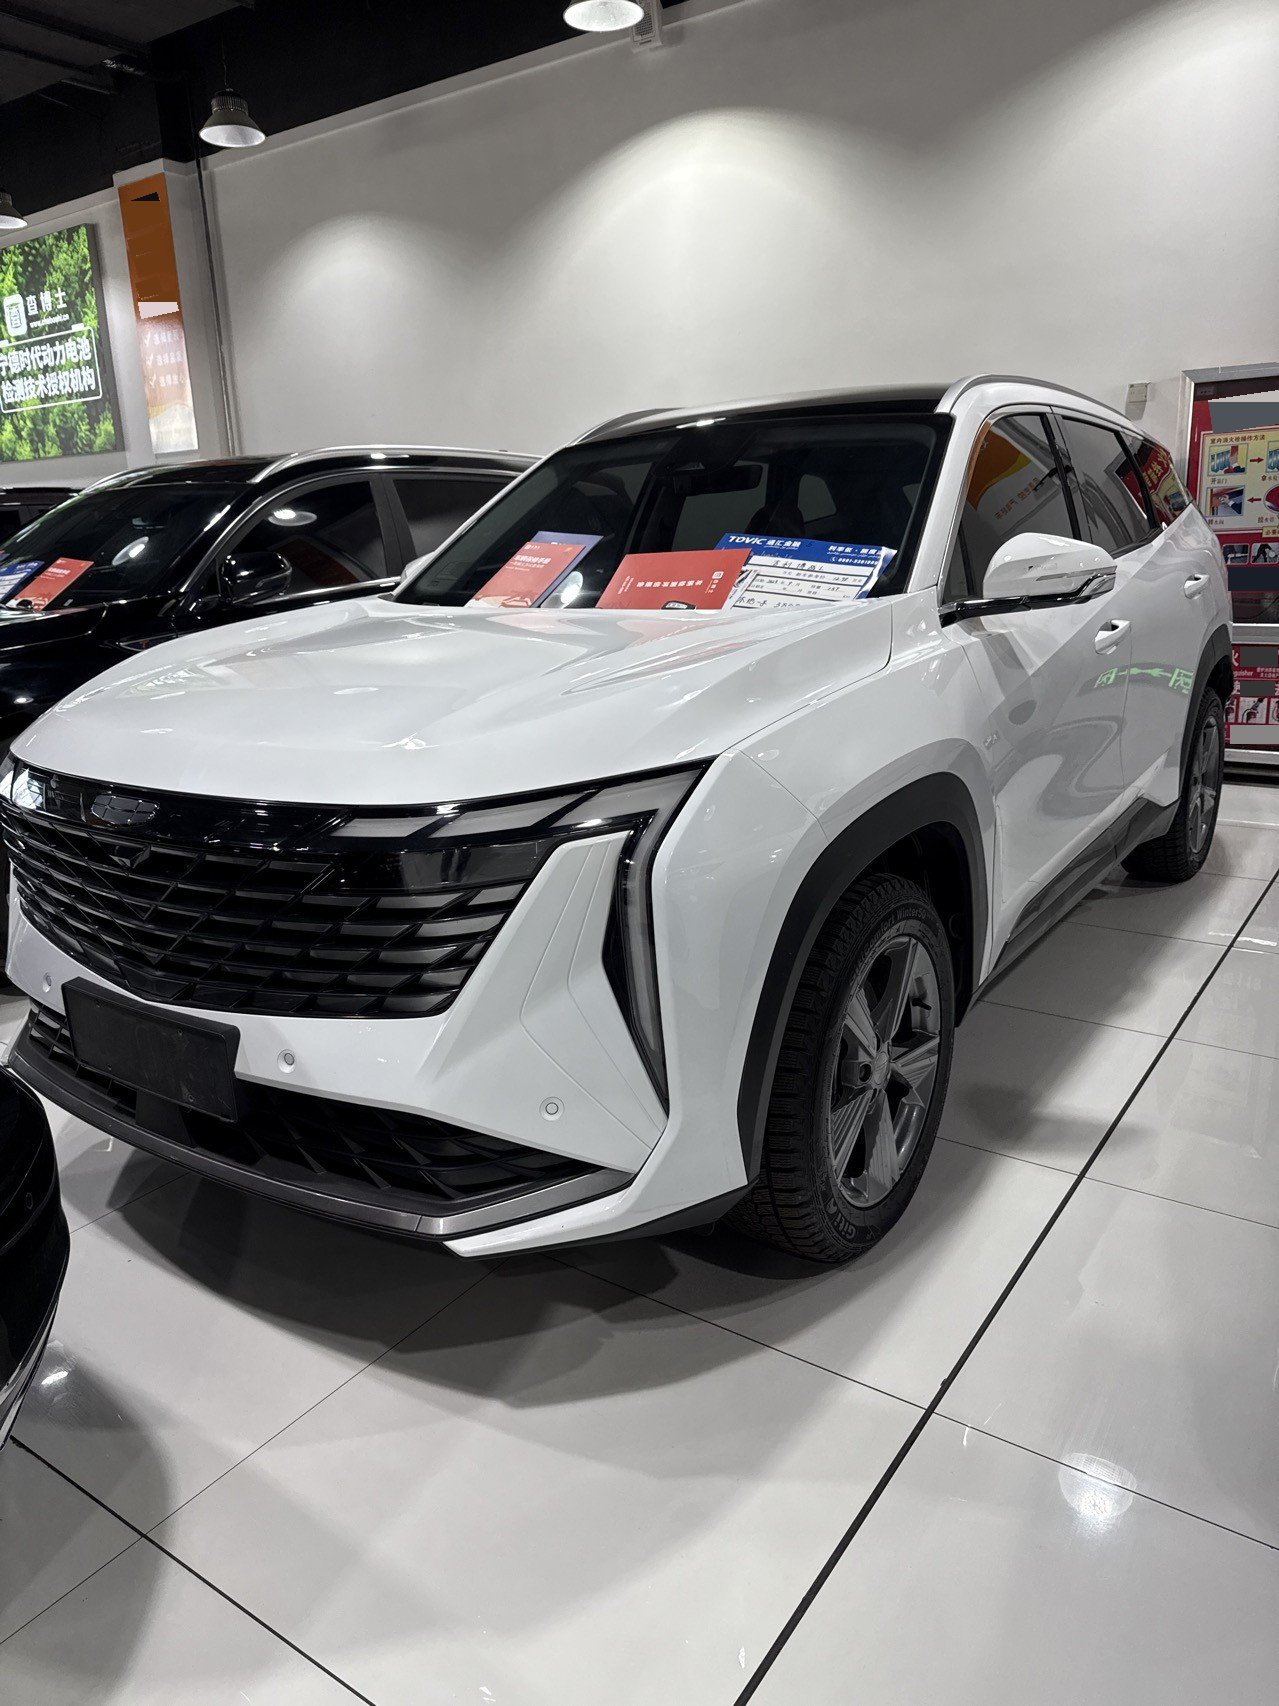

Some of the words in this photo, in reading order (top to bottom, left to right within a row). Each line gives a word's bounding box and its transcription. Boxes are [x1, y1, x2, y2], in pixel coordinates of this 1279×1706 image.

[26, 287, 67, 315] 查博士
[0, 336, 92, 377] 宁德时代动力电池
[1, 365, 96, 404] 检测技术授权机构
[1210, 434, 1265, 444] 室内消火栓操作方法
[728, 536, 767, 545] TOVIC
[833, 1211, 858, 1240] Giti
